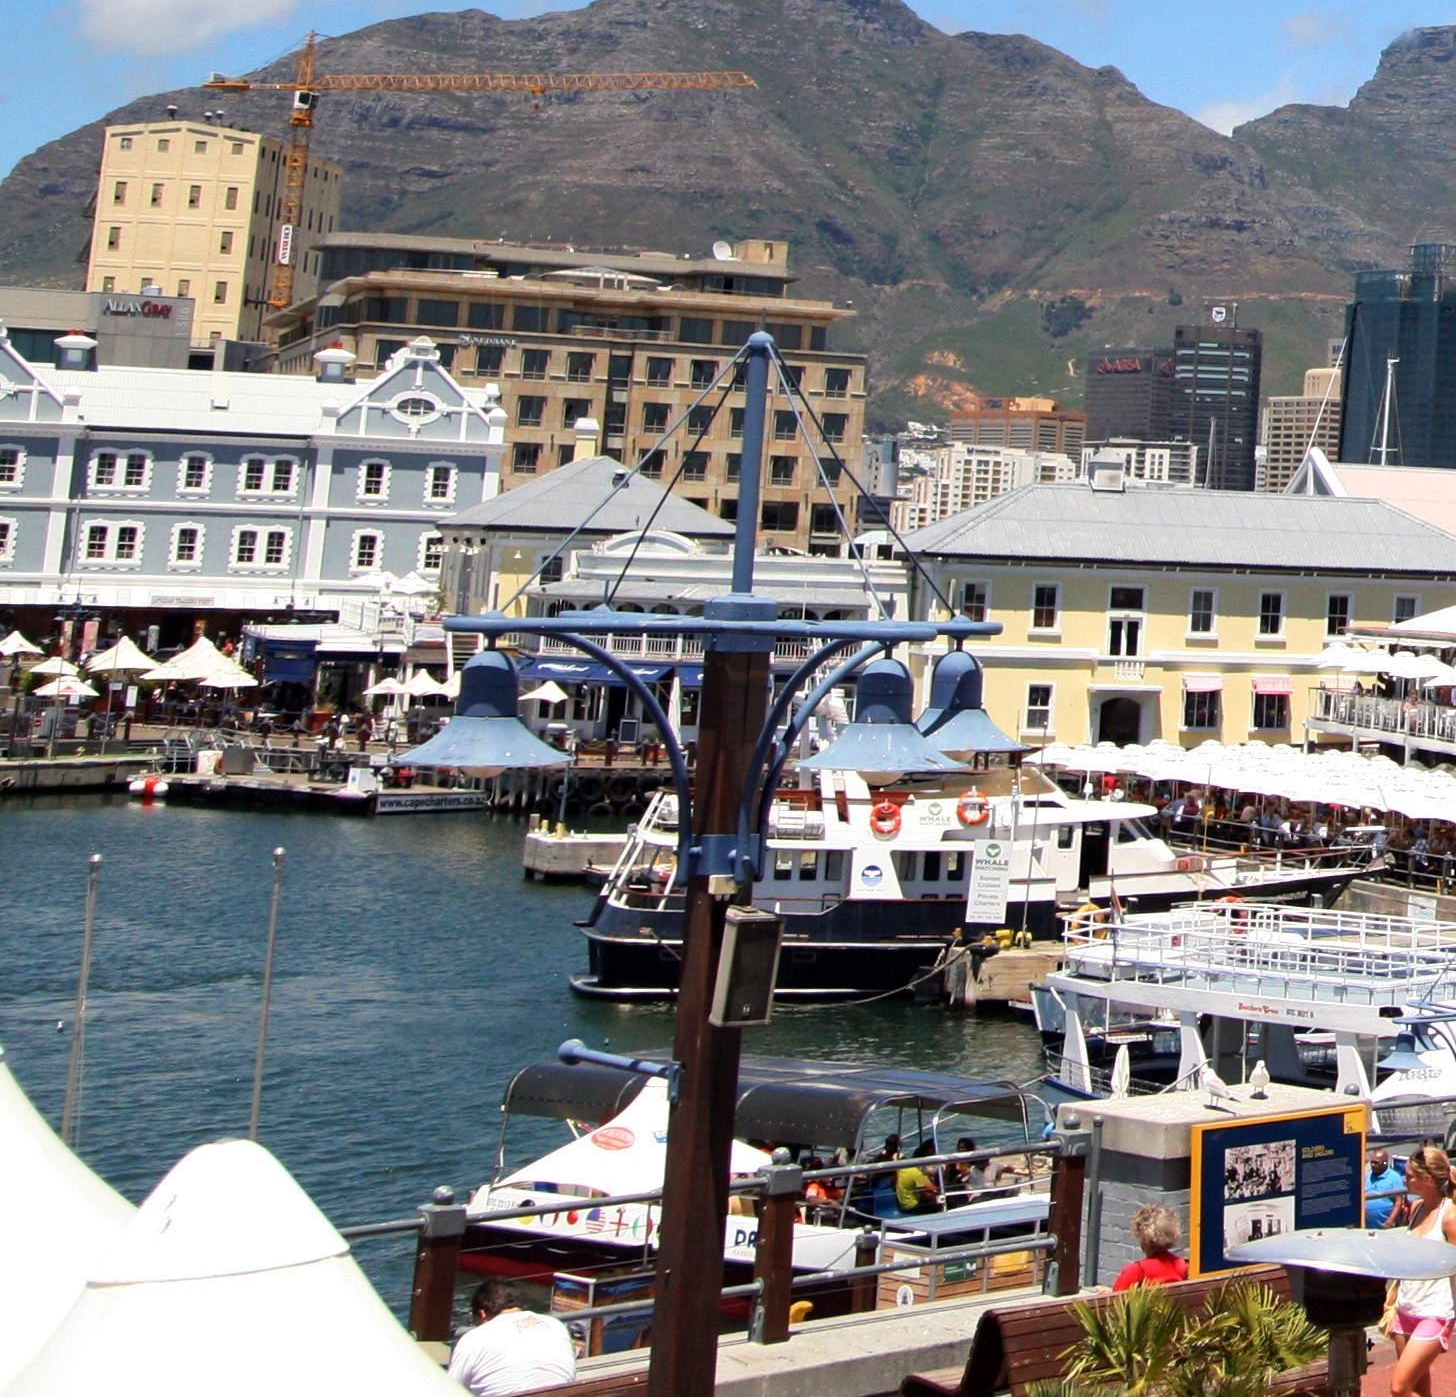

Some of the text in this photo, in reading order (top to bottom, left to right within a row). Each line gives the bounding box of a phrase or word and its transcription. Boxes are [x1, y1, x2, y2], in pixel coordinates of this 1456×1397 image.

[1114, 359, 1142, 373] ABSA
[919, 815, 950, 823] WHALE
[975, 858, 1009, 866] WHALE
